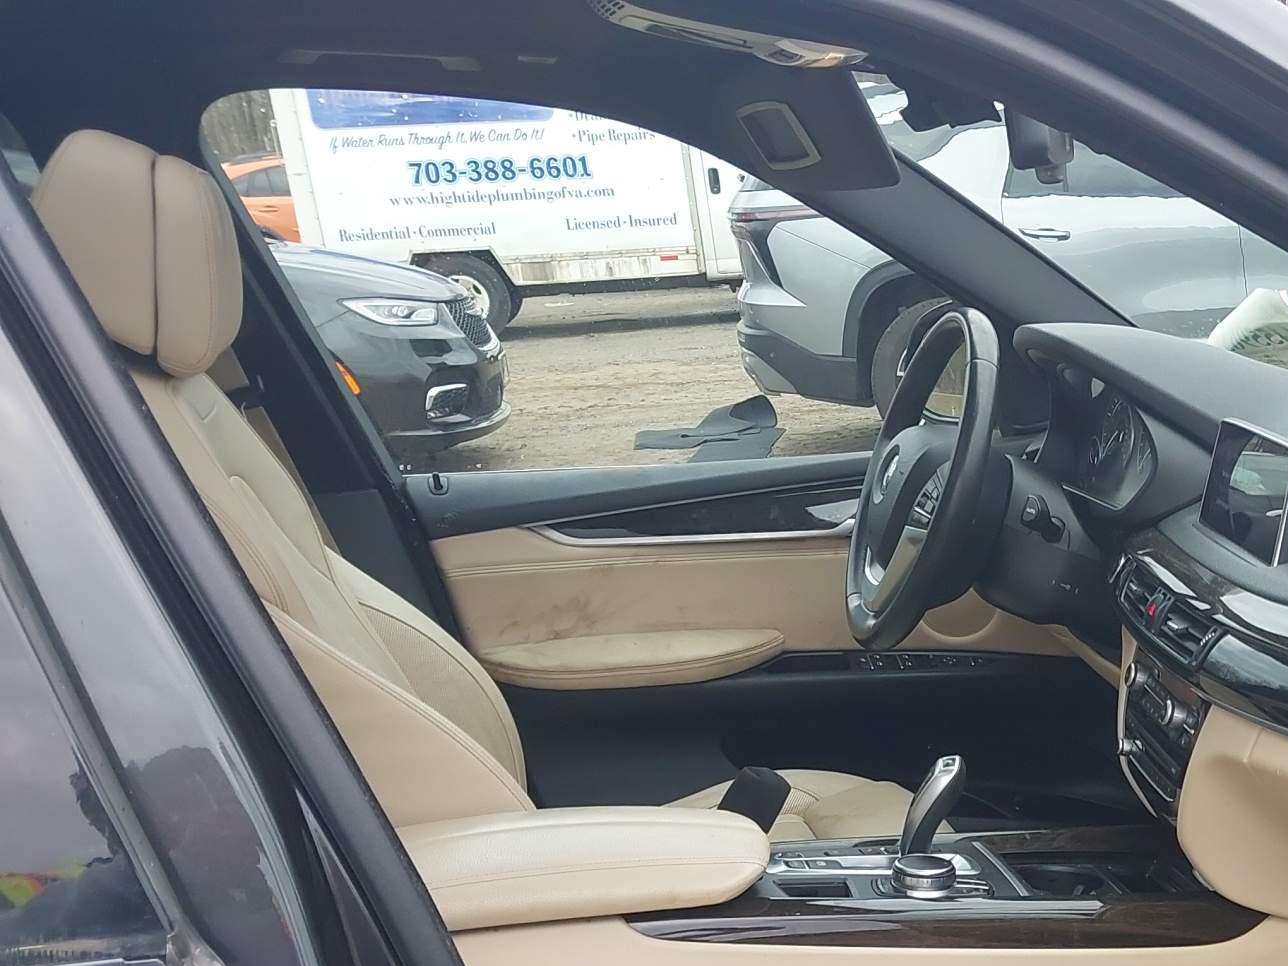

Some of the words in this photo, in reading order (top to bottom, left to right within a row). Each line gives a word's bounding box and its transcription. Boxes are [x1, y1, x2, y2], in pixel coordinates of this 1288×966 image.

[329, 136, 338, 154] If
[341, 135, 374, 148] Water
[377, 134, 405, 146] Runs
[408, 131, 451, 150] Through
[469, 129, 485, 142] We
[488, 128, 510, 142] Can
[513, 128, 527, 141] Do
[578, 129, 605, 145] Pipe
[608, 128, 655, 144] Repairs
[408, 155, 592, 185] 703-388-6601
[389, 187, 616, 208] www.hightideplumbingofva.com
[339, 224, 412, 242] Residential
[419, 221, 497, 239] Commercial
[565, 214, 622, 231] Licensed
[628, 212, 678, 227] Insured
